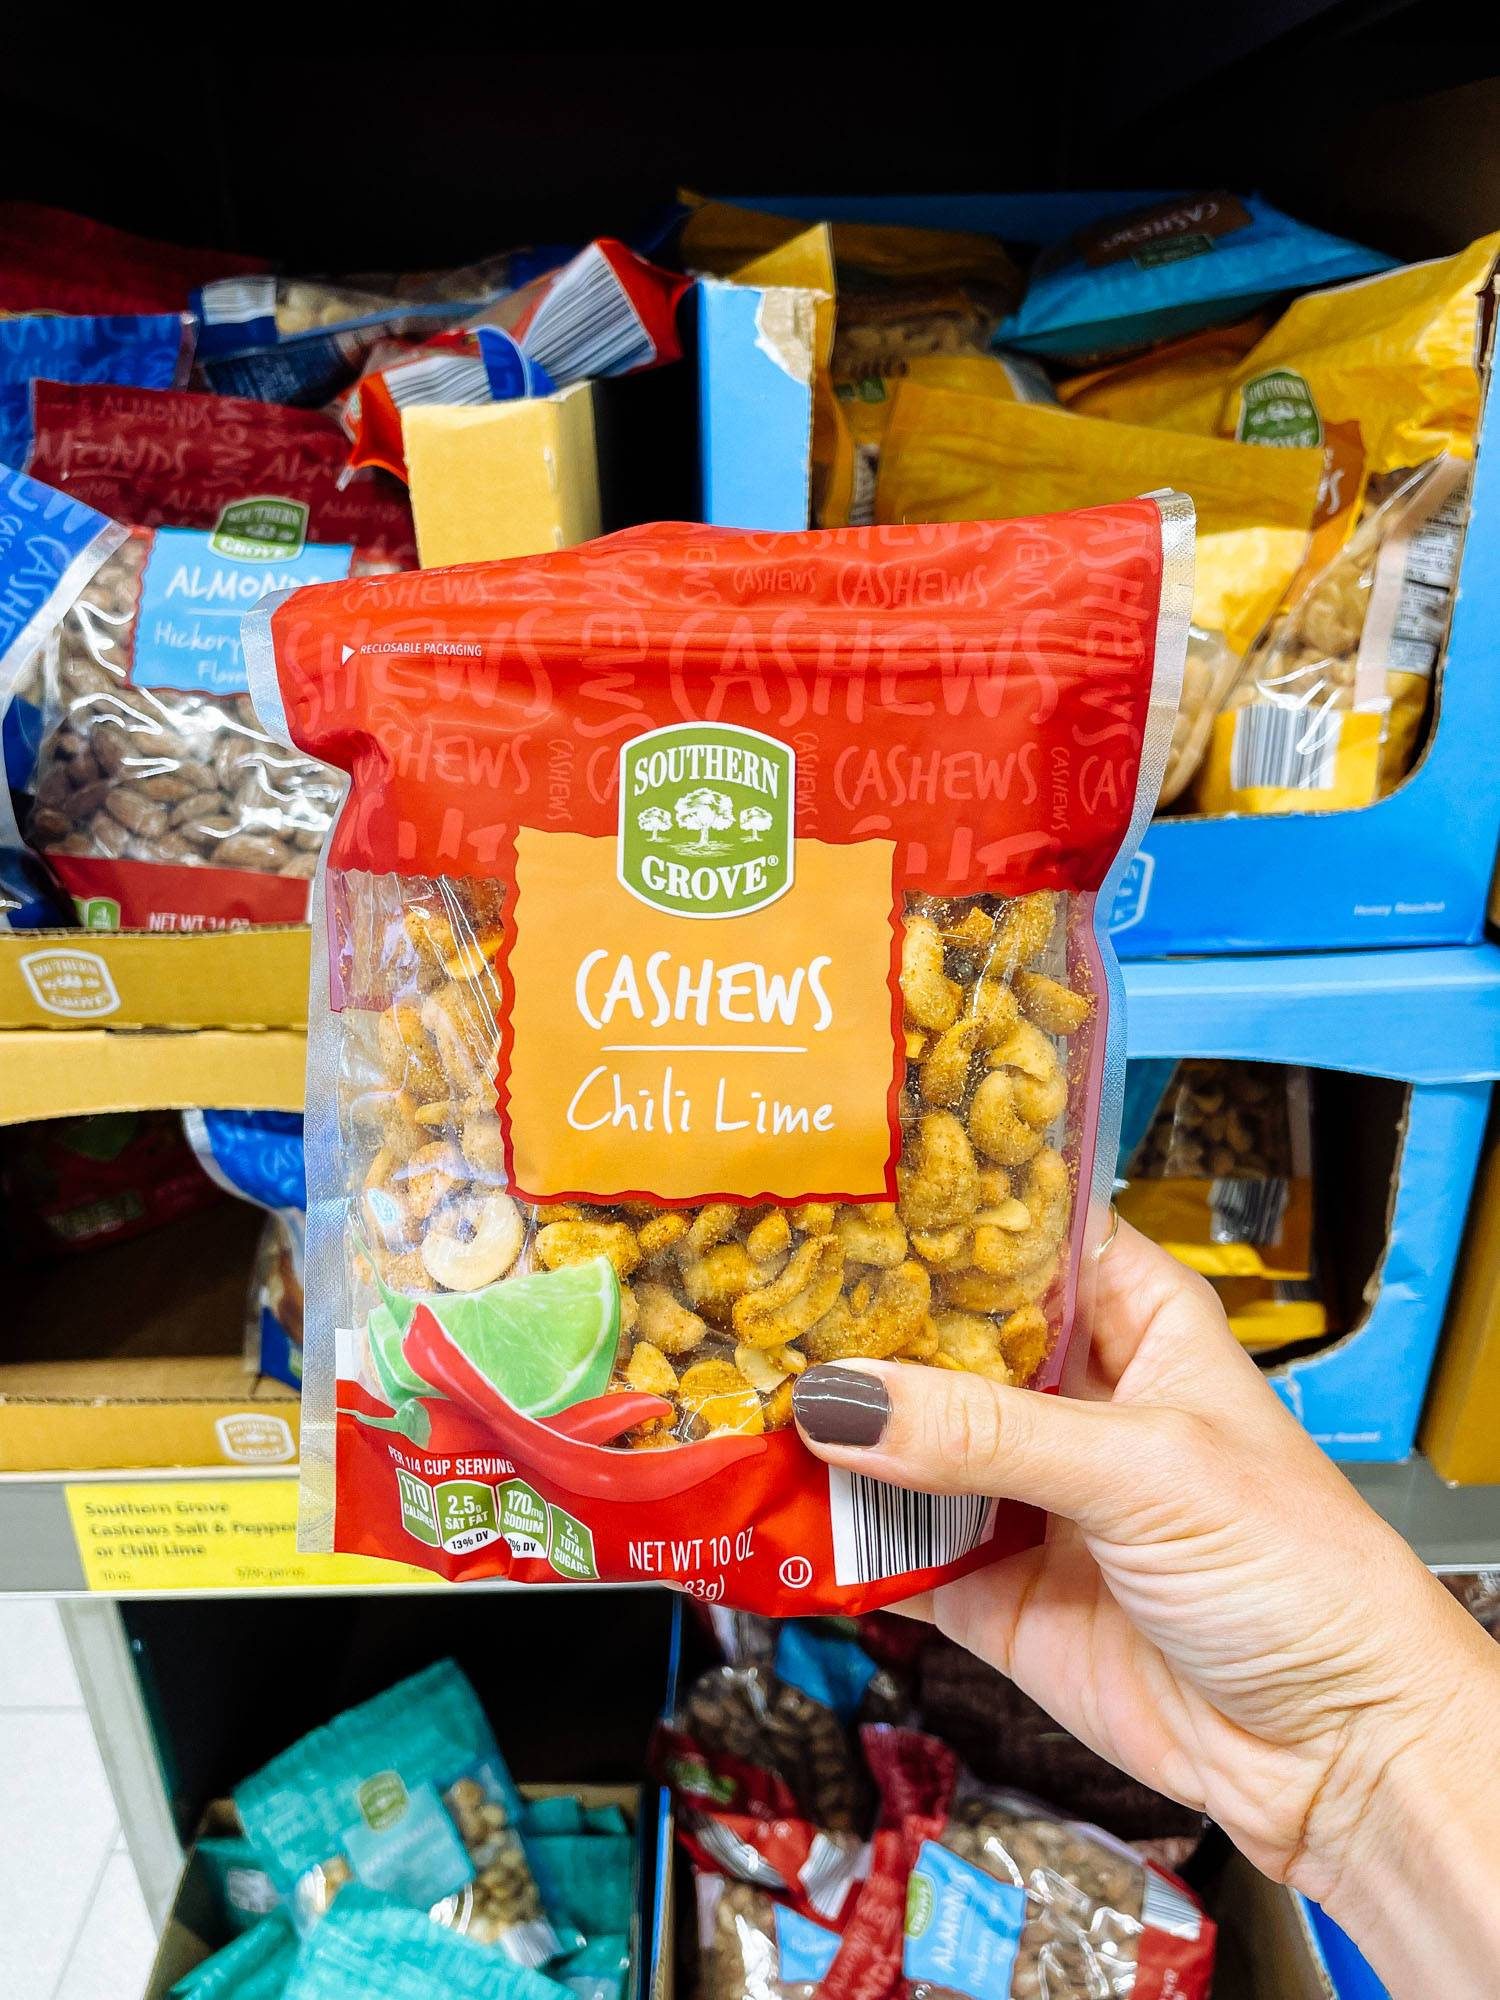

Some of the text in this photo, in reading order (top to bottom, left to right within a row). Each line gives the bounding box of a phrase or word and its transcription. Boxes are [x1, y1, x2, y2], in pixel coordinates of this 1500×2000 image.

[342, 574, 490, 612] CASHEWS
[733, 567, 818, 593] CASHEWS
[838, 562, 989, 609] CASHEWS
[360, 642, 482, 657] RECLOSABLE PACKAGING
[669, 605, 1060, 727] CASHEWS
[283, 609, 553, 735] SHEWS
[547, 738, 575, 821] CASHEWS
[634, 744, 780, 799] SOUTHERN
[834, 742, 1037, 808] CASHEWS
[1051, 747, 1071, 831] CASHEWS
[575, 949, 833, 1032] CASHEWS
[566, 1065, 835, 1135] Chili Lime
[387, 1445, 516, 1475] PER 1/4 CUP SERVING
[84, 1500, 230, 1515] Southern Grove
[400, 1475, 429, 1513] 170
[445, 1510, 489, 1530] SAT FAT
[504, 1511, 544, 1534] SODIUM
[452, 1530, 489, 1550] 13% DV
[523, 1541, 537, 1552] DV
[560, 1534, 585, 1562] TOTAL
[628, 1526, 755, 1573] NET WT 10 OZ
[554, 1549, 591, 1576] SUGARS
